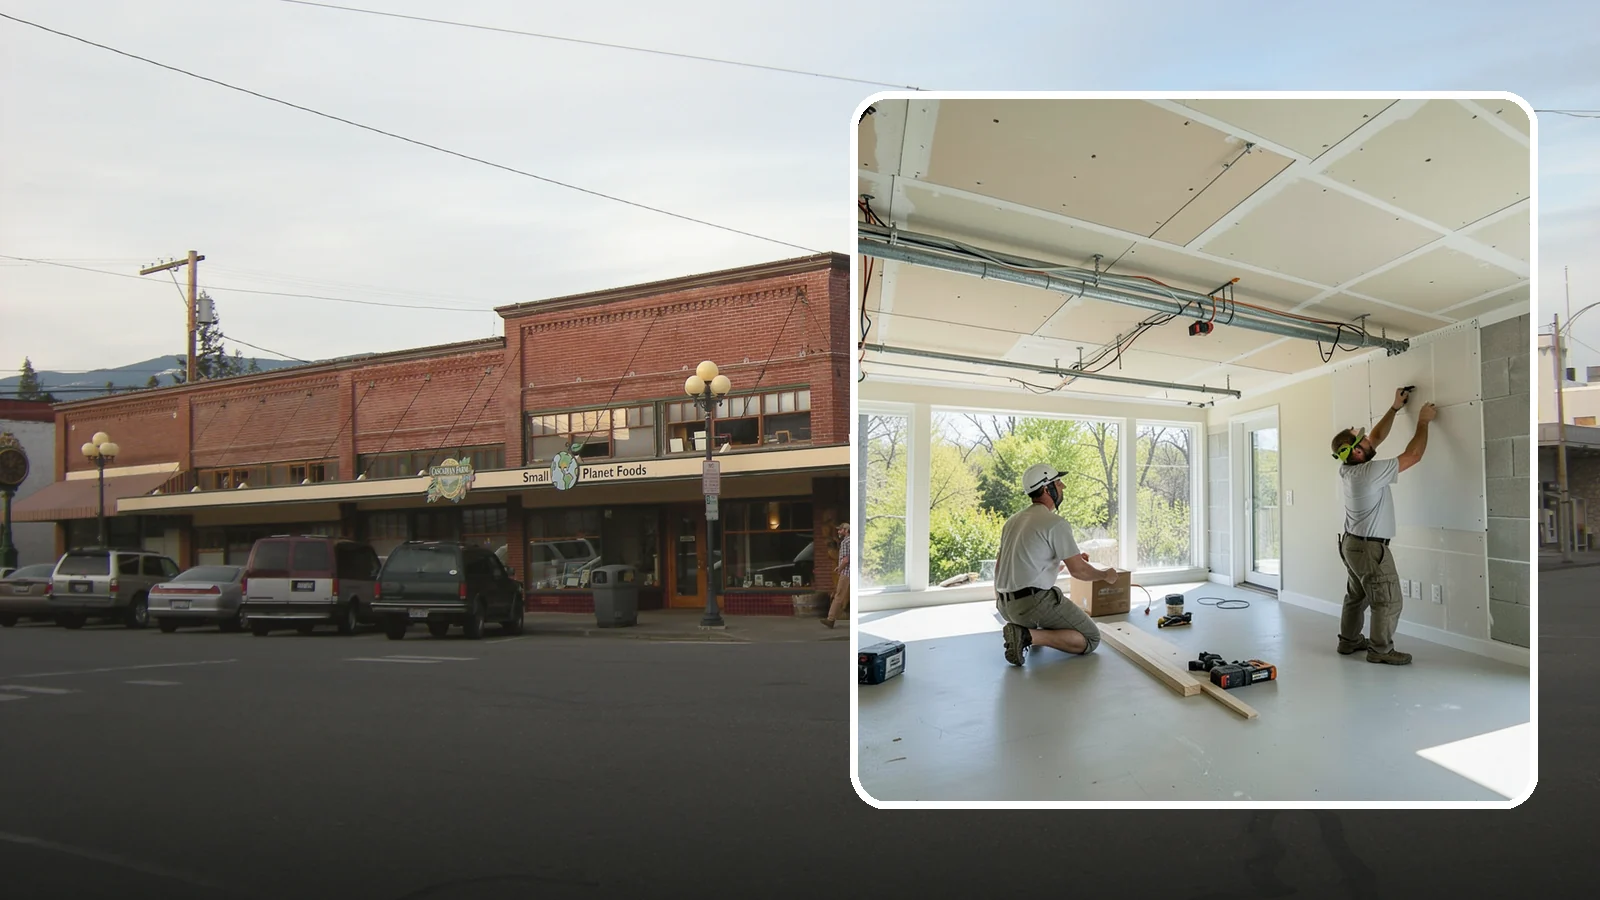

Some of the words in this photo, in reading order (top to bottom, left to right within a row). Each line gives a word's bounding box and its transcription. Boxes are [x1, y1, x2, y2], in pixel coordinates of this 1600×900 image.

[523, 471, 549, 483] Small
[583, 467, 614, 479] Planet
[617, 464, 647, 477] Foods
